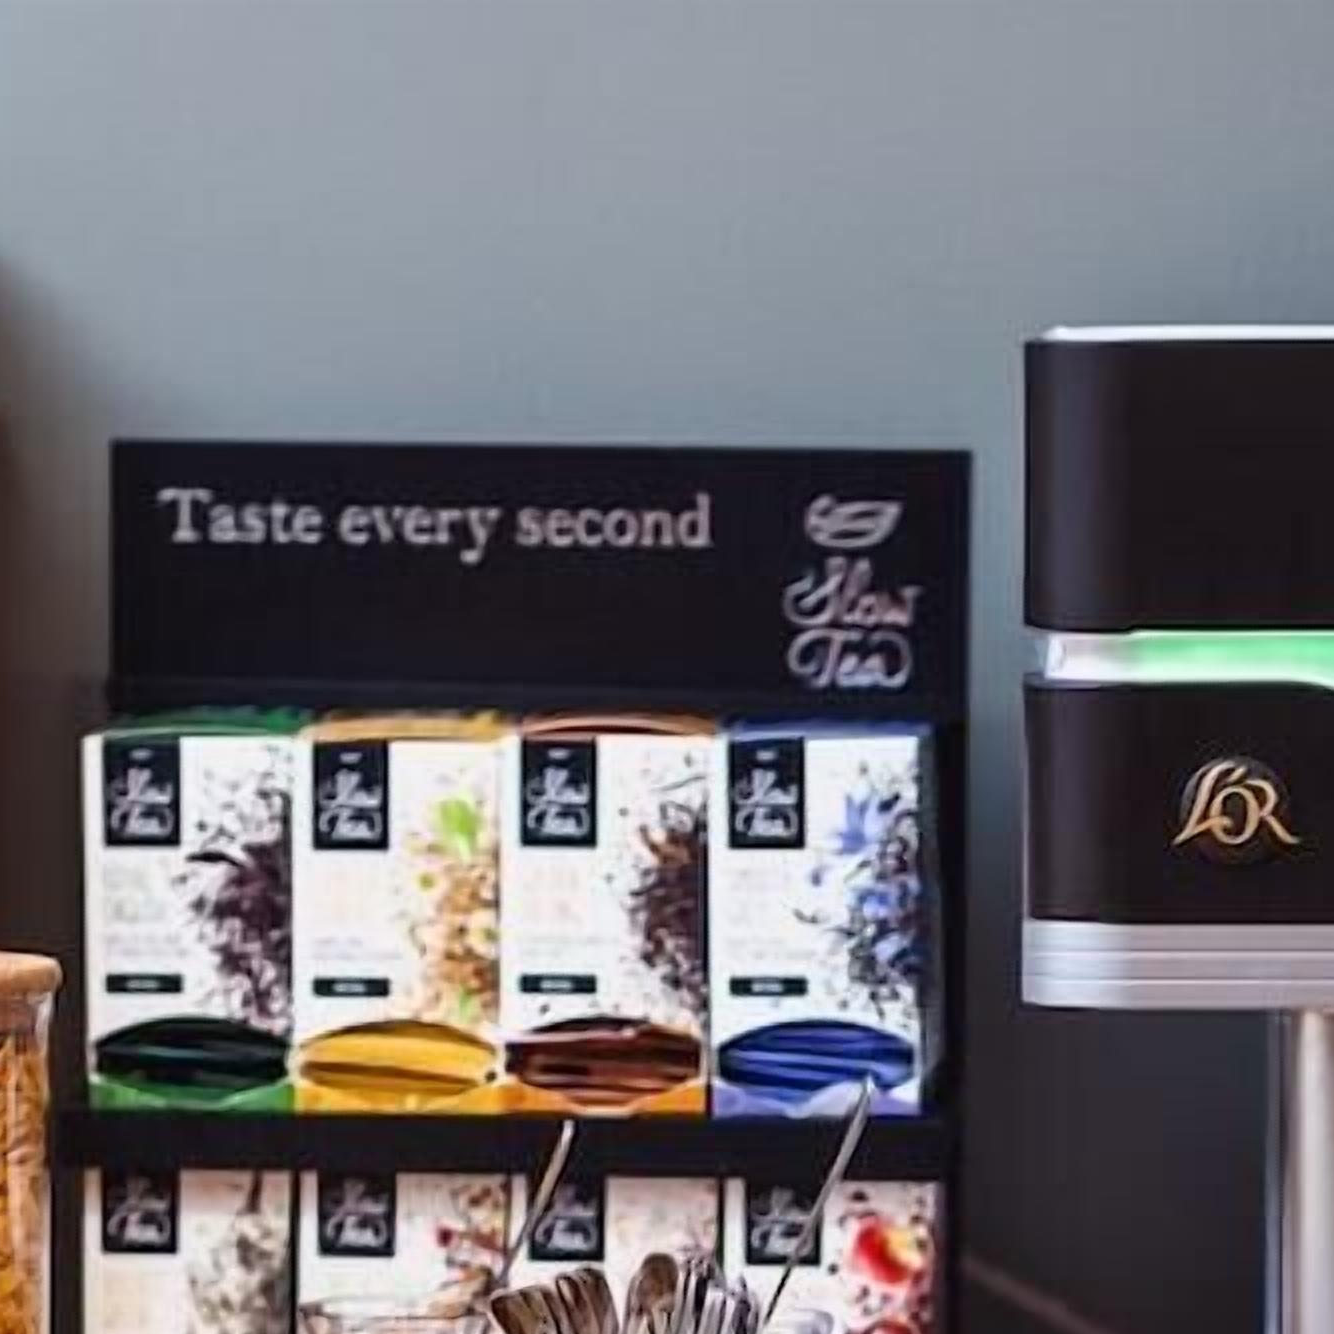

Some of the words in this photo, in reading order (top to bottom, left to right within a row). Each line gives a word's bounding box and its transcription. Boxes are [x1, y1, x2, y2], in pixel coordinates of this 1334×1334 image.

[156, 486, 324, 545] Taste
[338, 503, 501, 566] every
[513, 492, 712, 547] second
[781, 555, 924, 628] Slow
[786, 627, 913, 689] Tea
